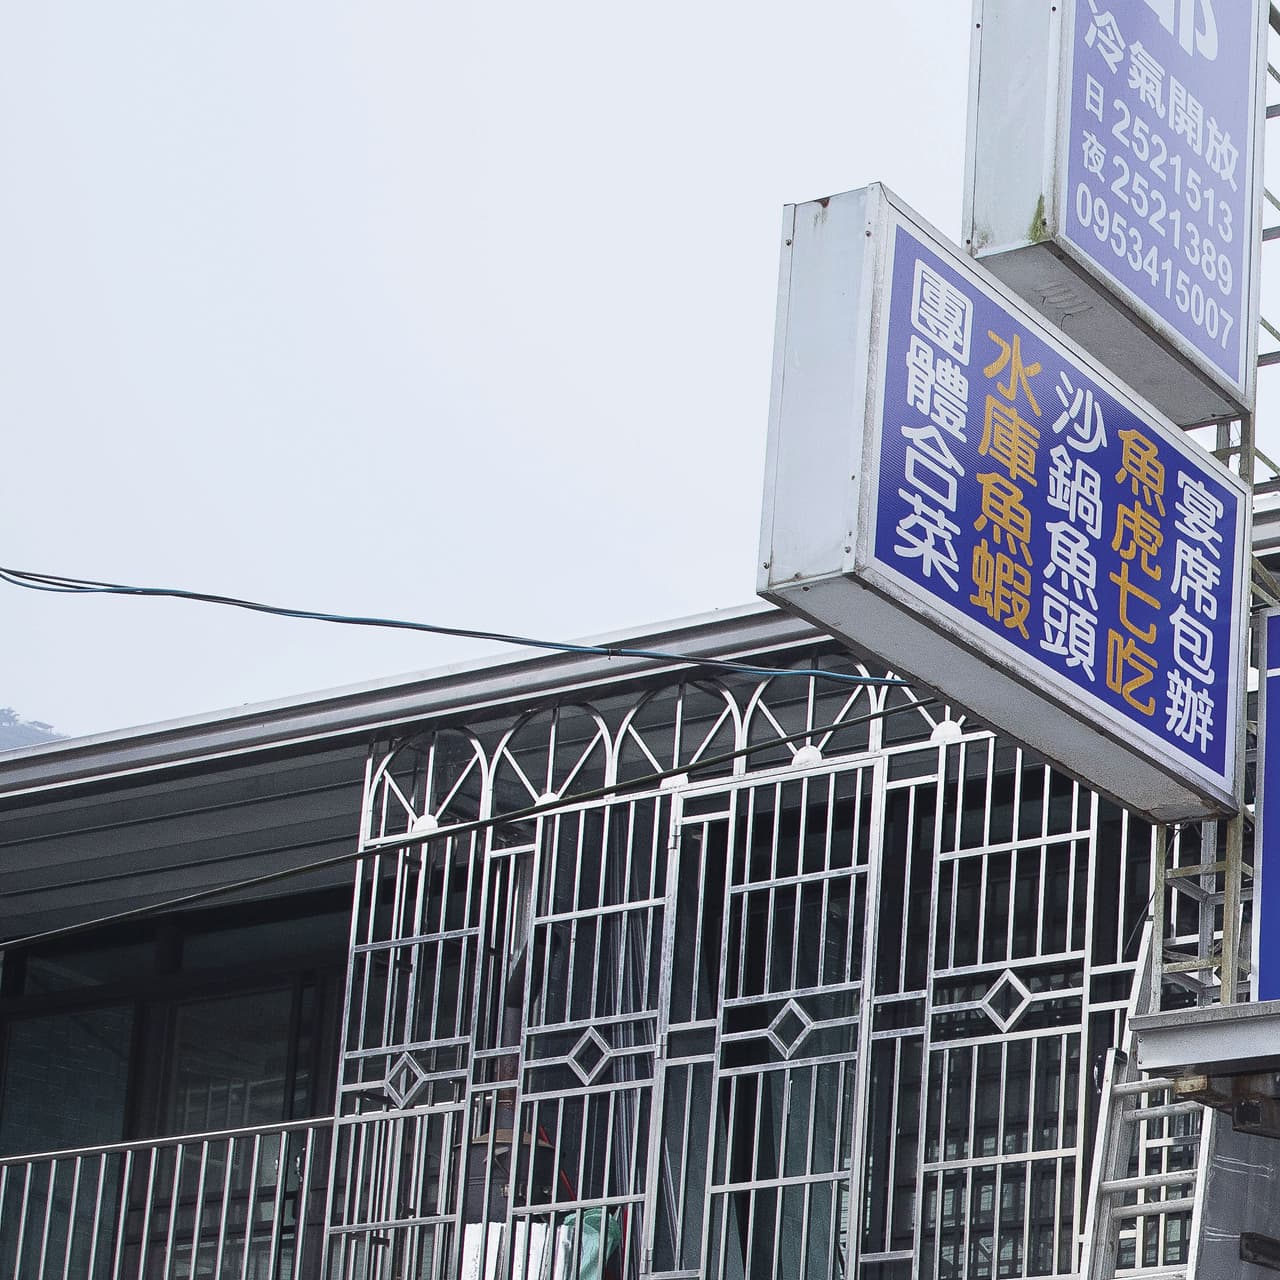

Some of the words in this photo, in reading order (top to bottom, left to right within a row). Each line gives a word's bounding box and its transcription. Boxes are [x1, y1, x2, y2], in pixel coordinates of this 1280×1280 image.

[1082, 130, 1107, 183] 夜
[1110, 155, 1233, 295] 2521389
[1084, 0, 1239, 192] 冷氣開放
[1085, 73, 1104, 122] 日
[1111, 99, 1233, 243] 2521513
[1076, 182, 1234, 349] 0953415007
[894, 258, 973, 593] 團體合菜
[970, 329, 1042, 641] 水庫魚蝦
[1040, 370, 1106, 682] 沙鍋魚頭
[1105, 428, 1167, 718] 魚虎七吃
[1165, 468, 1225, 756] 宴席包辦
